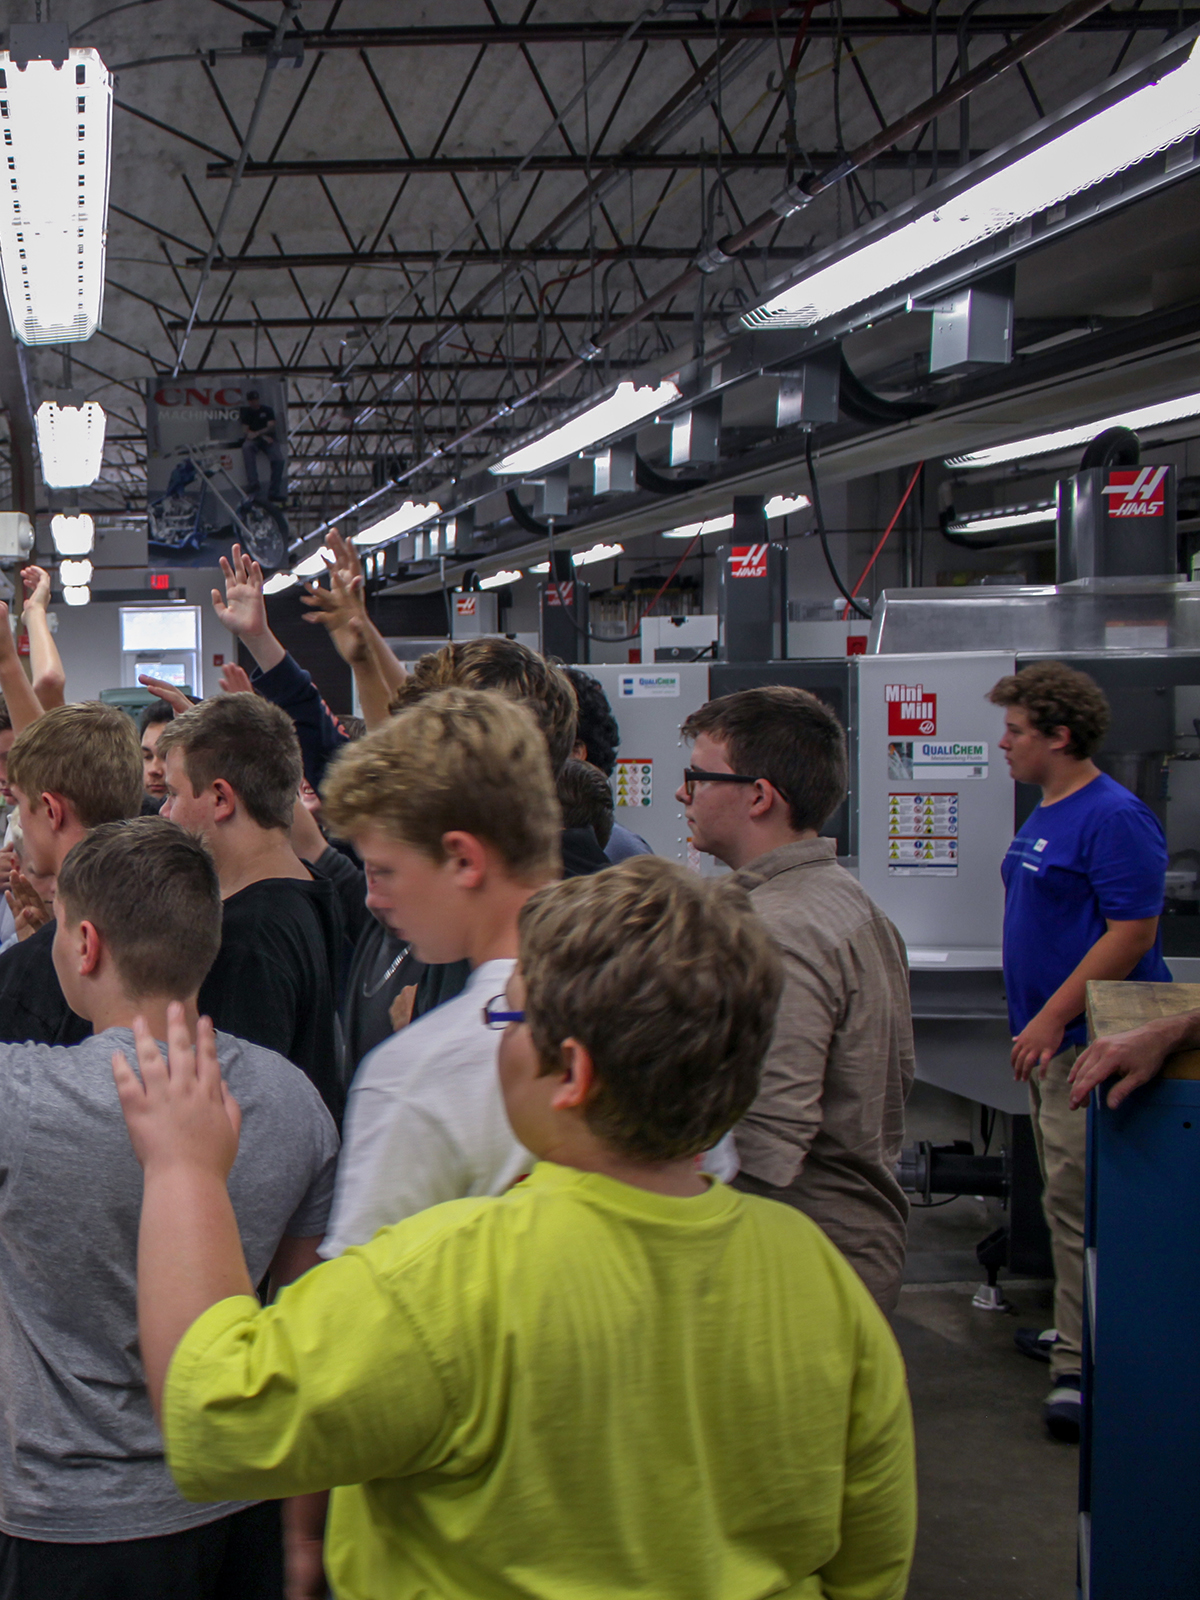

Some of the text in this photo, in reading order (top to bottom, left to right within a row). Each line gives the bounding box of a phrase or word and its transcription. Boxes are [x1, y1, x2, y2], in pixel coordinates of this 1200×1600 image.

[154, 387, 243, 407] CNC
[158, 408, 242, 421] MACHINING
[1108, 501, 1165, 516] HAAS
[731, 566, 767, 577] HAAS
[886, 685, 922, 702] Mini
[901, 702, 933, 719] Mill
